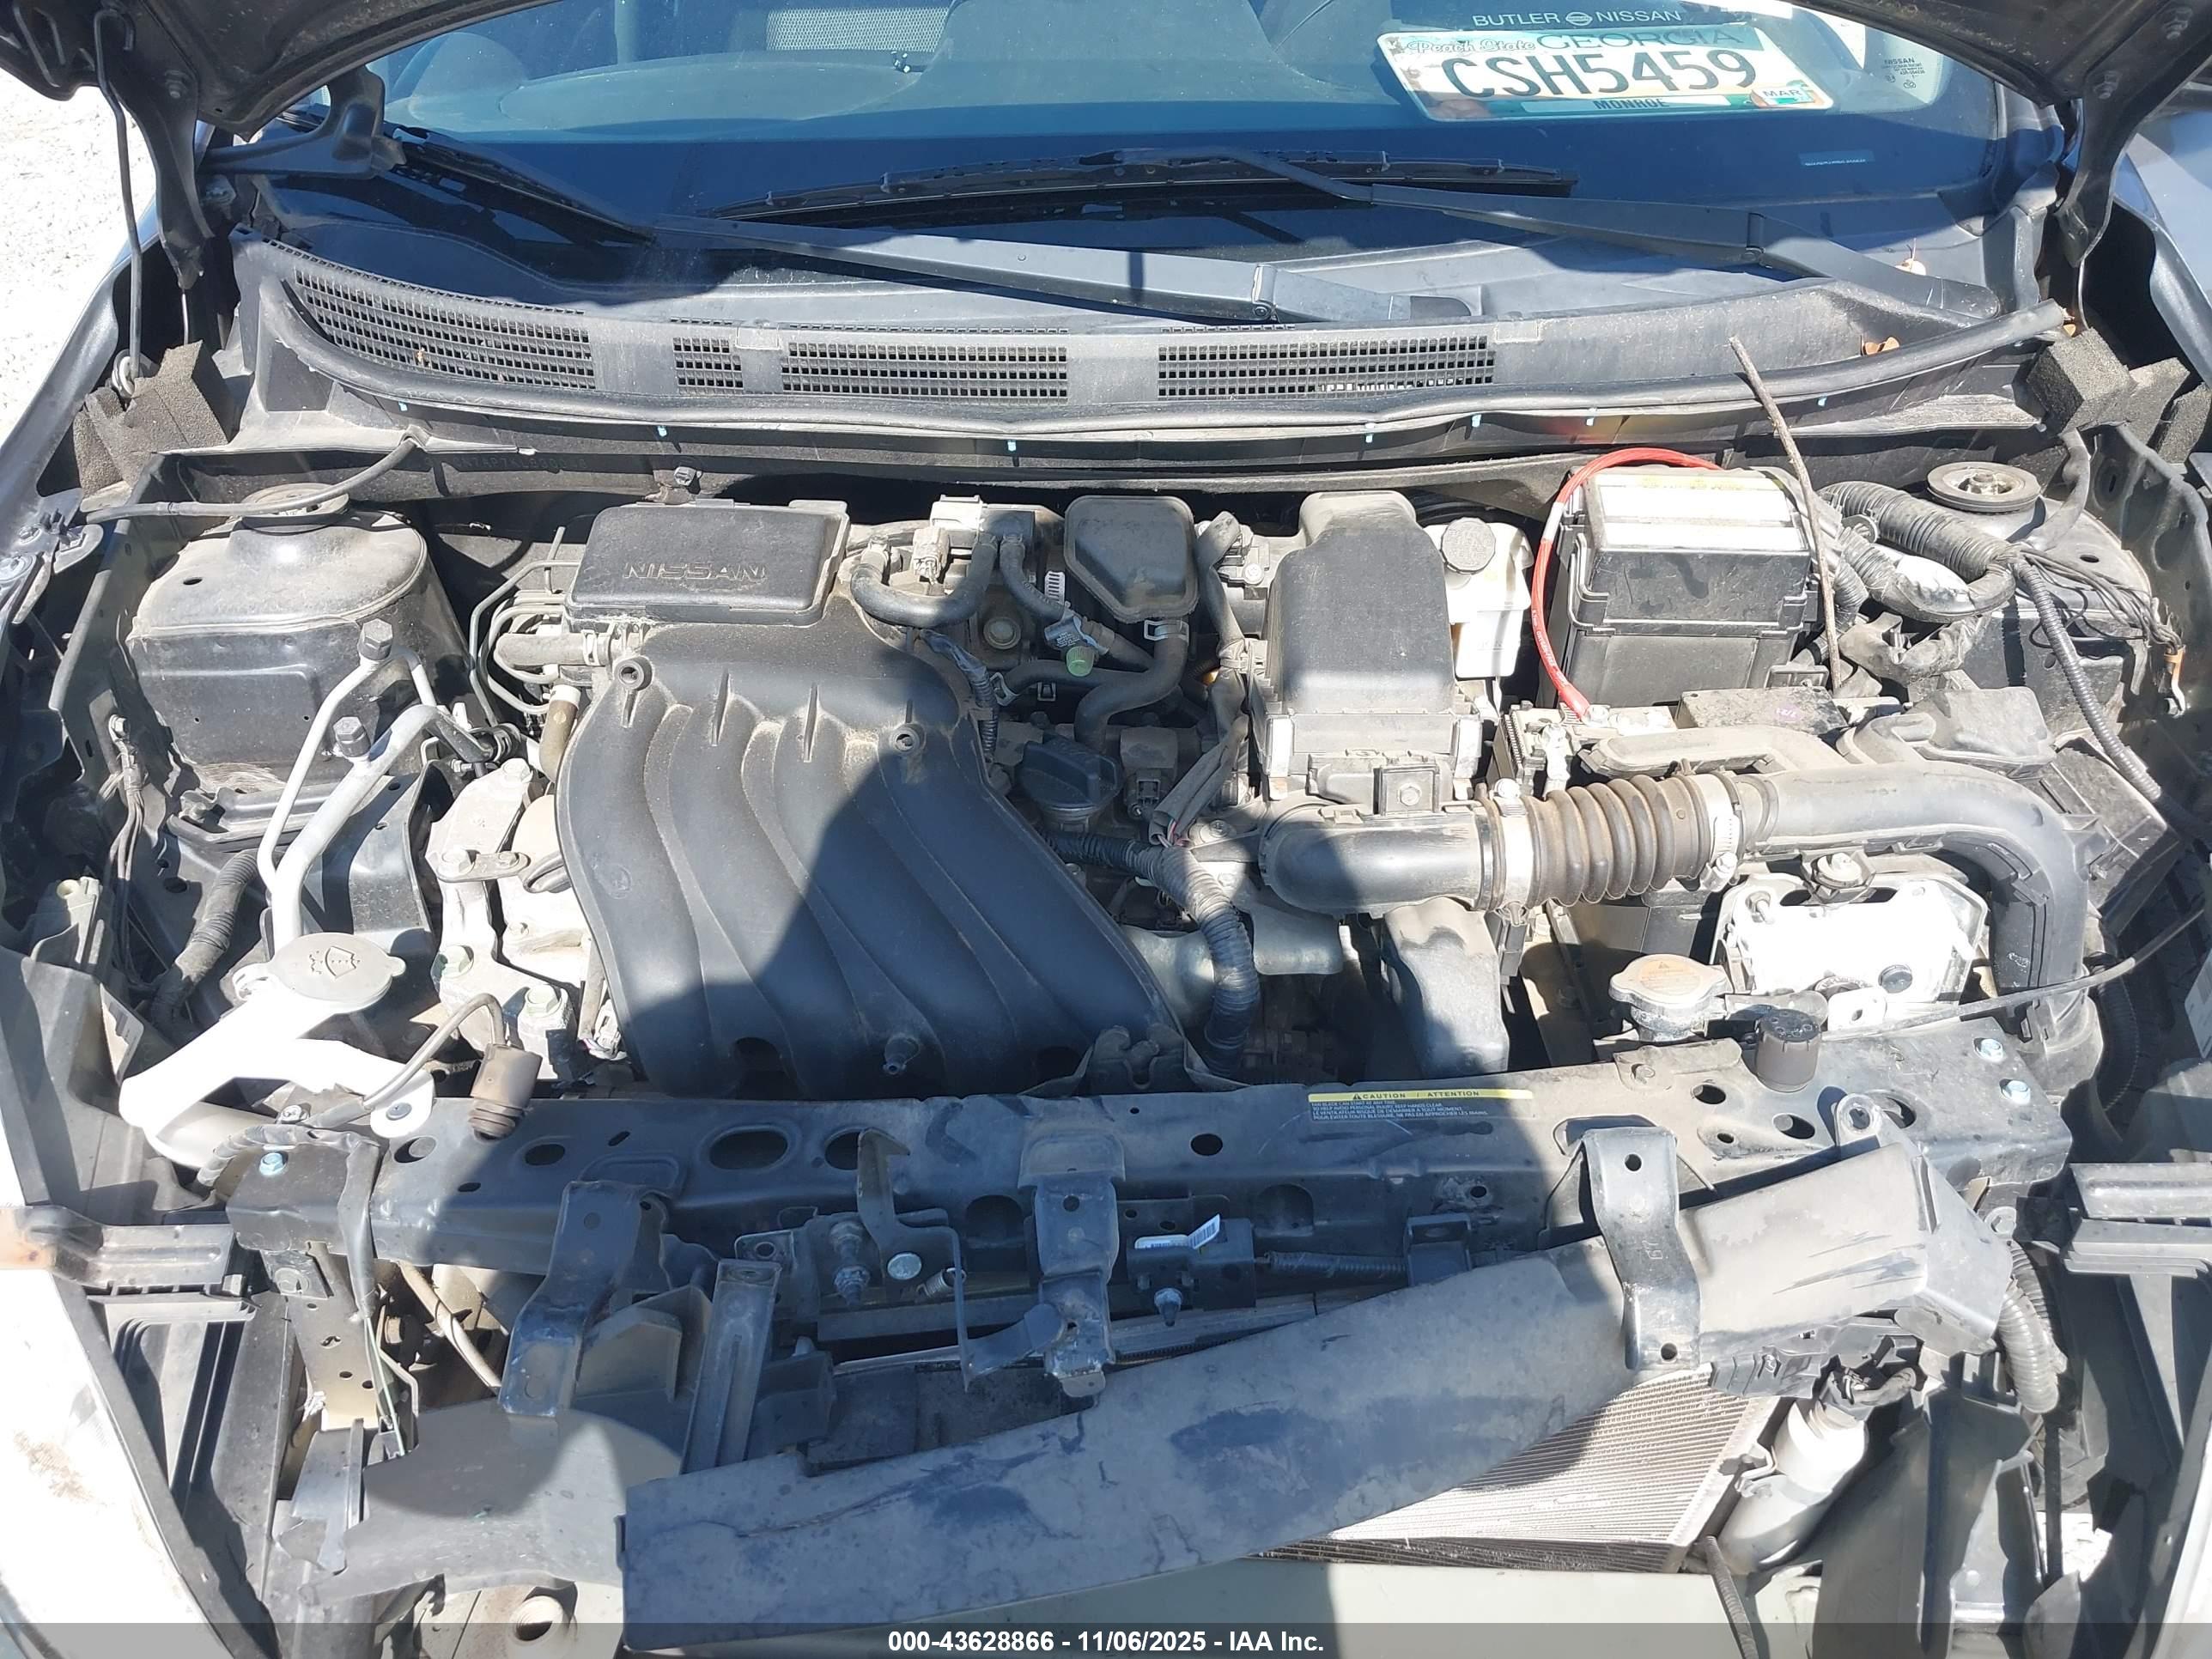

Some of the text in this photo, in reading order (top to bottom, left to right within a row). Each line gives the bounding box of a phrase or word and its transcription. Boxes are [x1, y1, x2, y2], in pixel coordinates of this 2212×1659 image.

[1472, 13, 1559, 27] BUTLER
[1595, 9, 1681, 23] NISSAN
[1406, 32, 1742, 54] Peach State GEORGIA
[1441, 50, 1757, 98] CSH5459
[1762, 89, 1801, 98] MAR
[1593, 97, 1669, 110] MONROE
[622, 562, 769, 582] NISSAN
